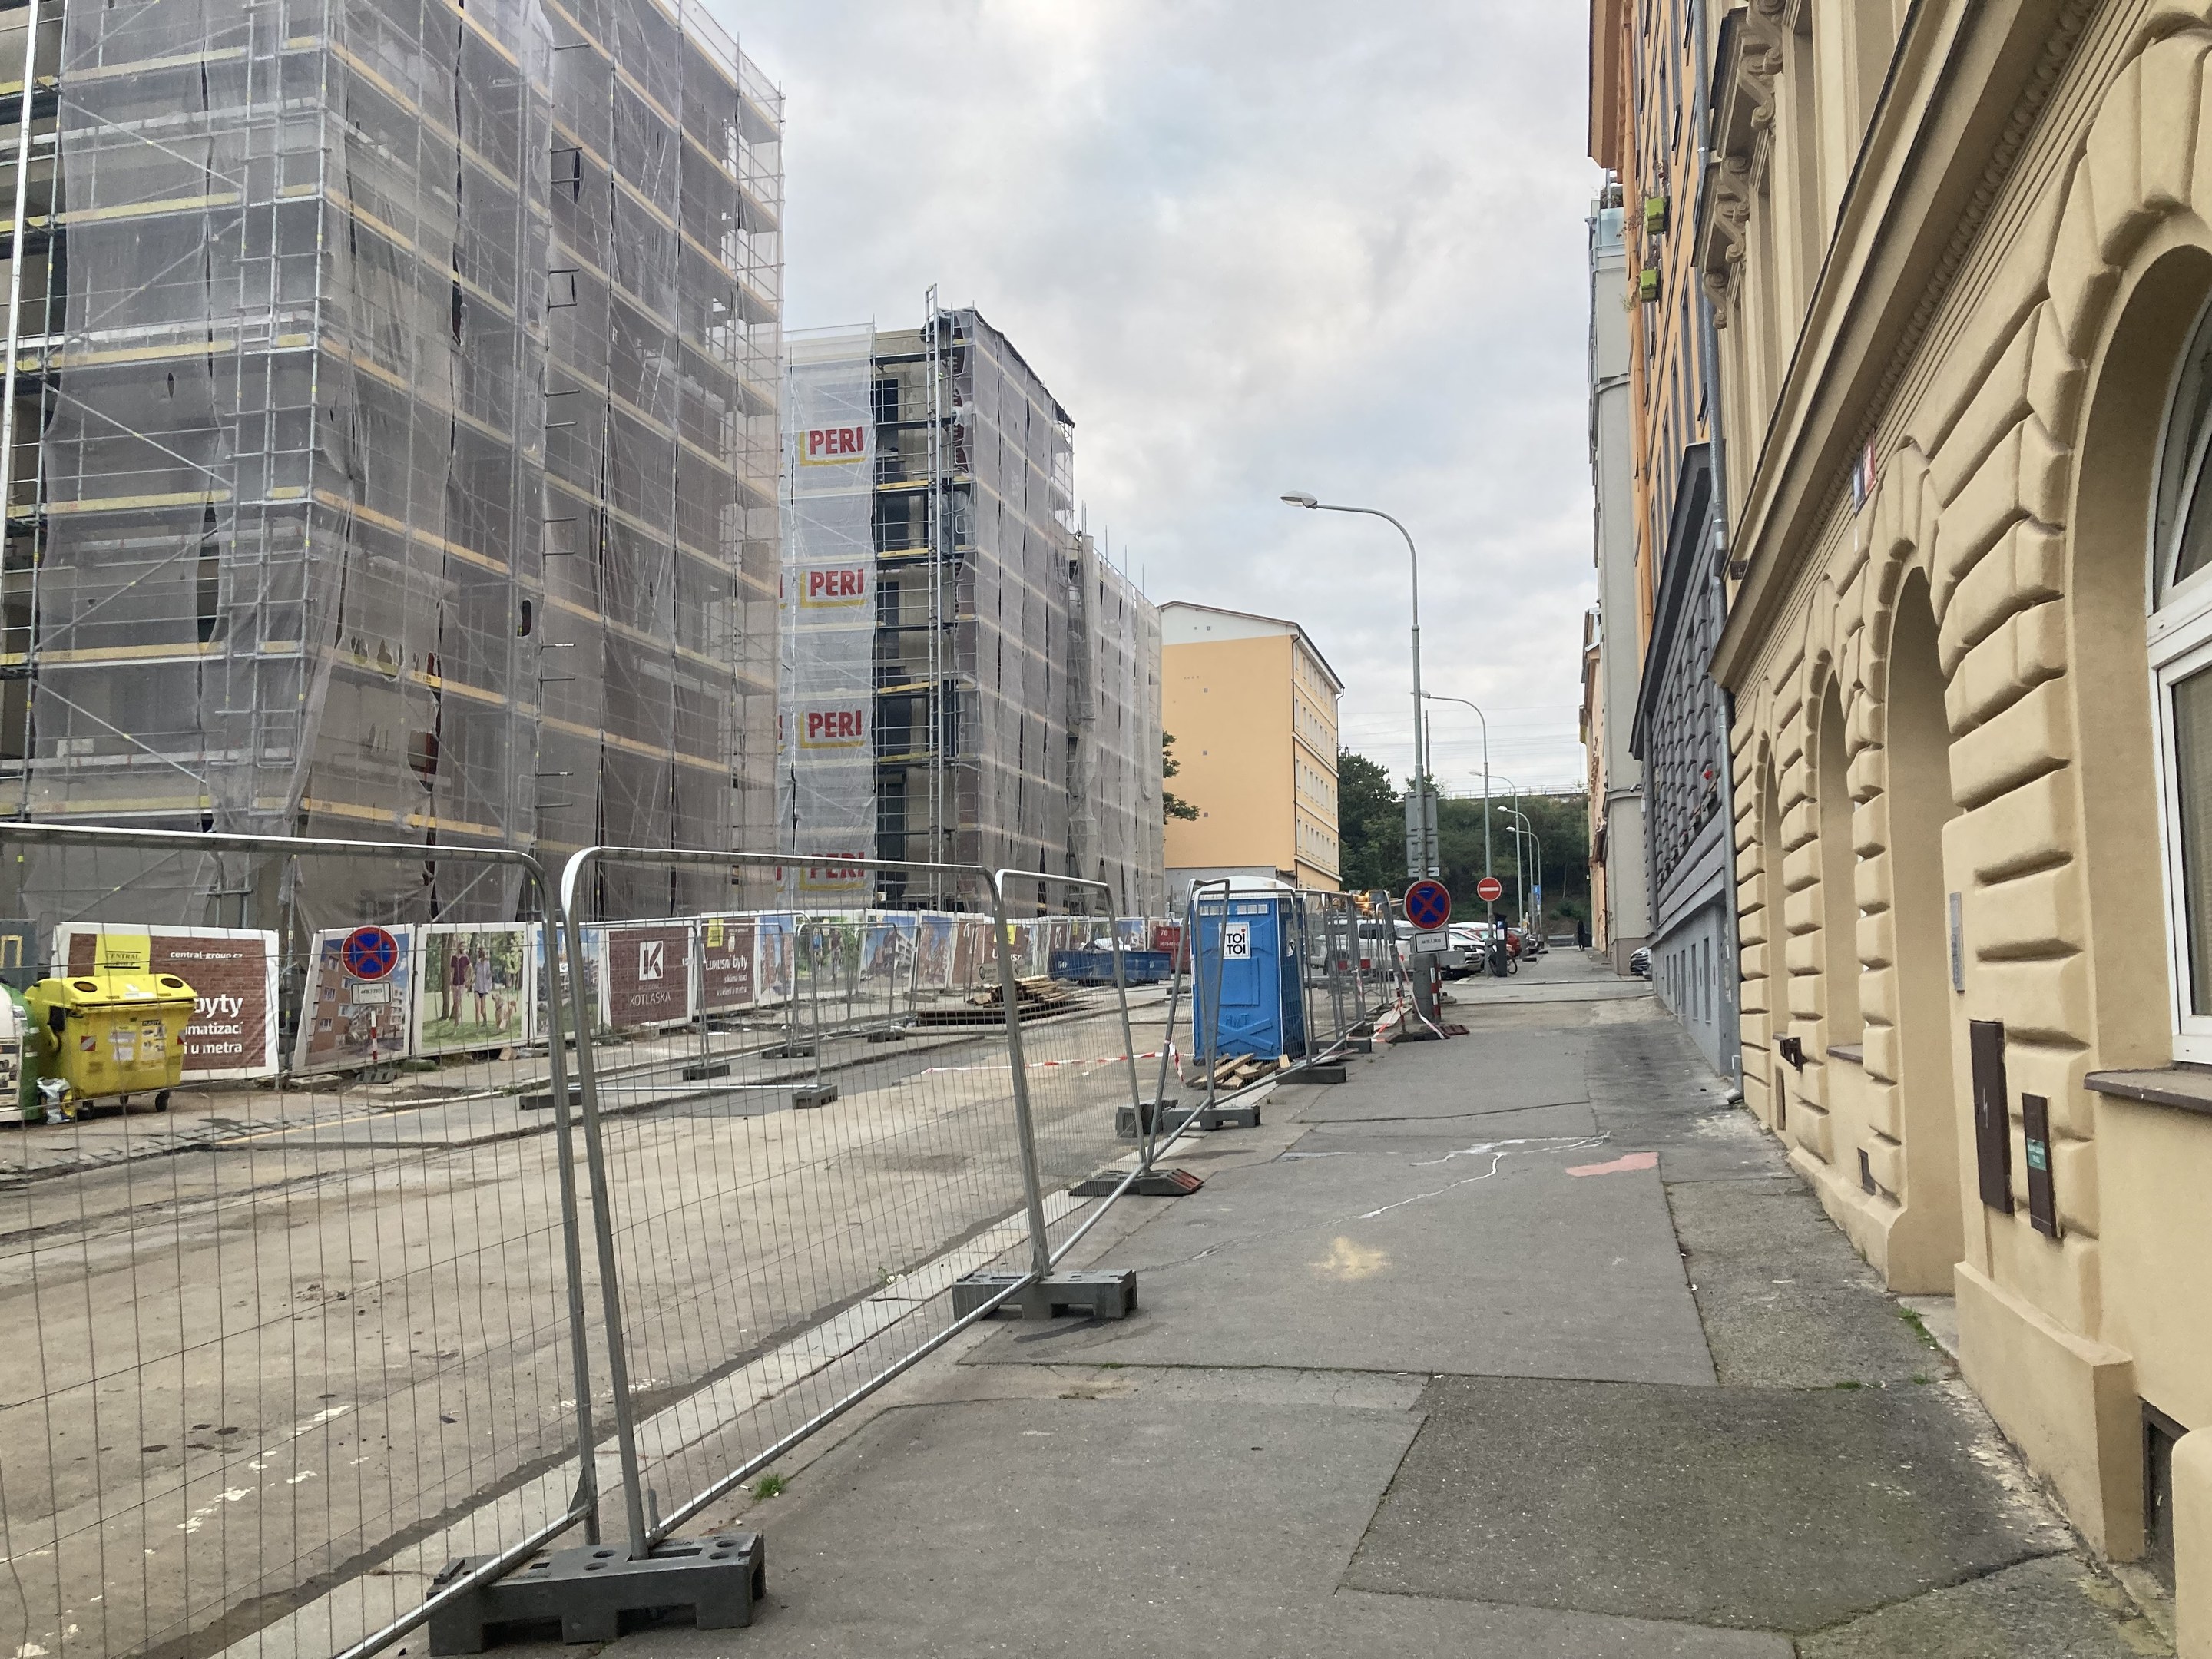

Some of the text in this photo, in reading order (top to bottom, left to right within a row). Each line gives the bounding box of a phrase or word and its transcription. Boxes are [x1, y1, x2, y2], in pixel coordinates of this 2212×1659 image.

[810, 426, 863, 455] PERI
[810, 569, 863, 597] PERI
[809, 710, 862, 737] PERI
[810, 852, 864, 879] PERI
[1227, 933, 1245, 944] TOI
[1227, 944, 1245, 954] TOI
[644, 942, 663, 978] K
[733, 955, 748, 971] byty
[631, 992, 671, 1007] KOTLASKA
[203, 1041, 243, 1054] metra
